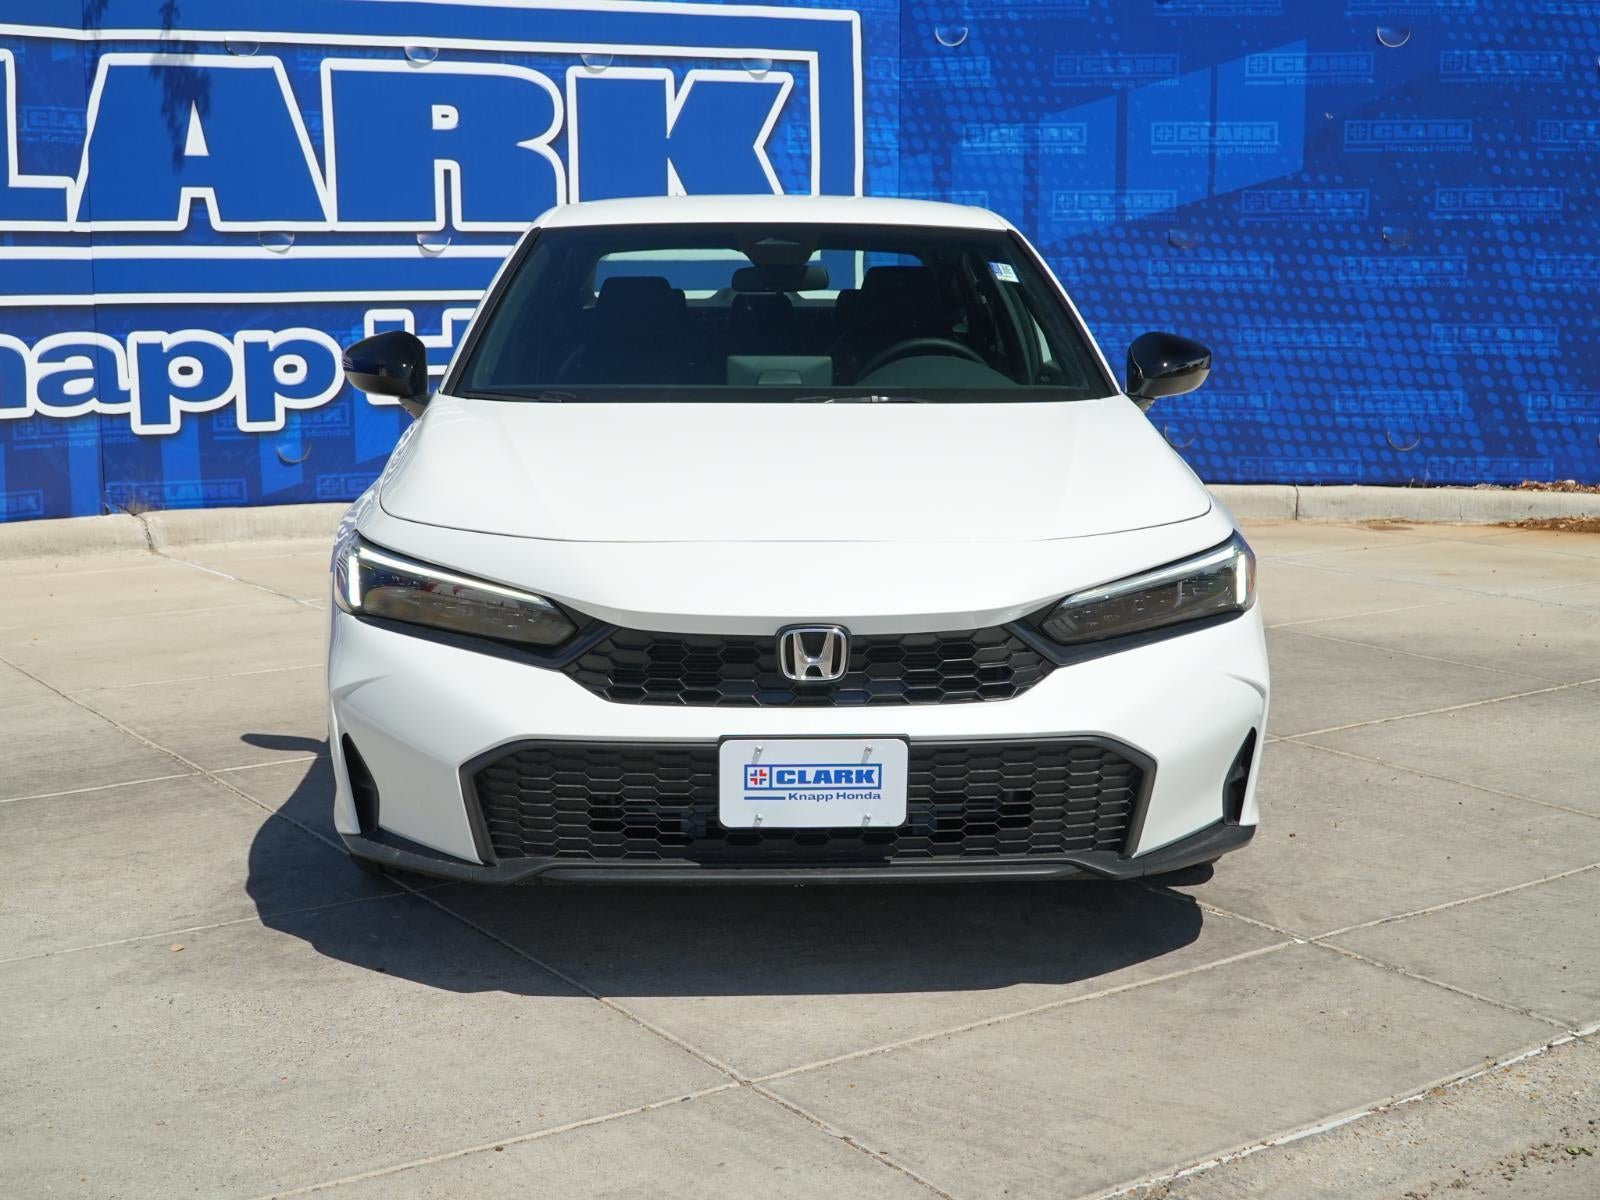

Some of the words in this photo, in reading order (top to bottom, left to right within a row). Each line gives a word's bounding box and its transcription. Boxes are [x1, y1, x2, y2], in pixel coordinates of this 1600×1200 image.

[1274, 57, 1368, 72] CLARK
[1180, 126, 1273, 141] CLARK
[1373, 124, 1466, 140] CLARK
[776, 769, 875, 785] CLARK
[788, 792, 833, 802] Knapp
[836, 791, 881, 801] Honda
